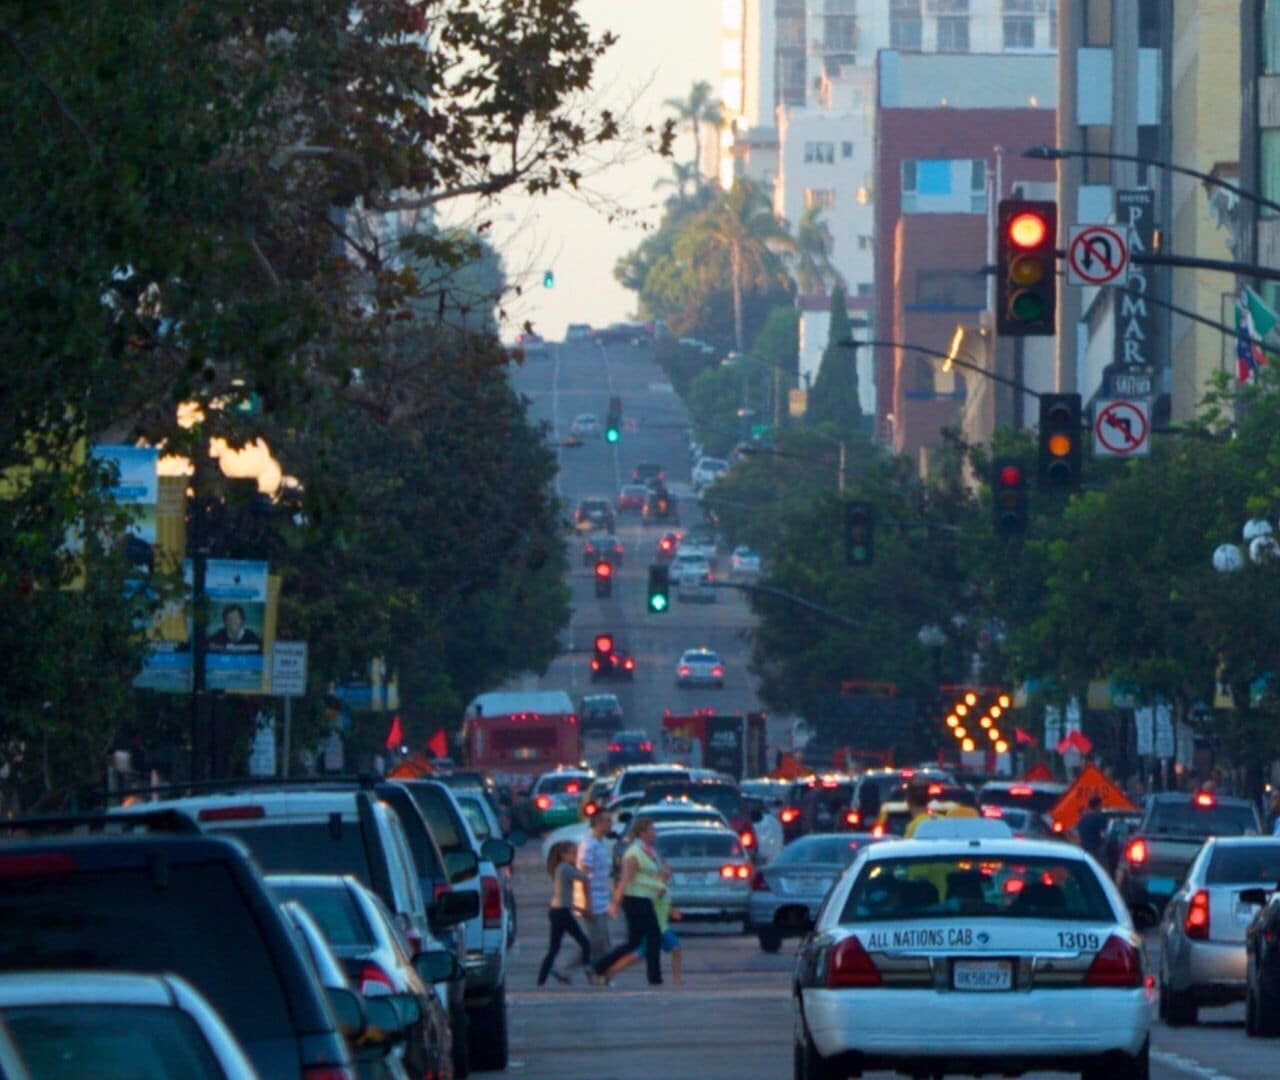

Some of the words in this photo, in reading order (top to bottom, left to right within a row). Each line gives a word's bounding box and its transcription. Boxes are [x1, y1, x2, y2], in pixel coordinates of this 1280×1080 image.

[869, 932, 890, 948] ALL
[892, 929, 944, 947] NATIONS
[947, 927, 973, 946] CAB
[1057, 931, 1099, 949] 1309
